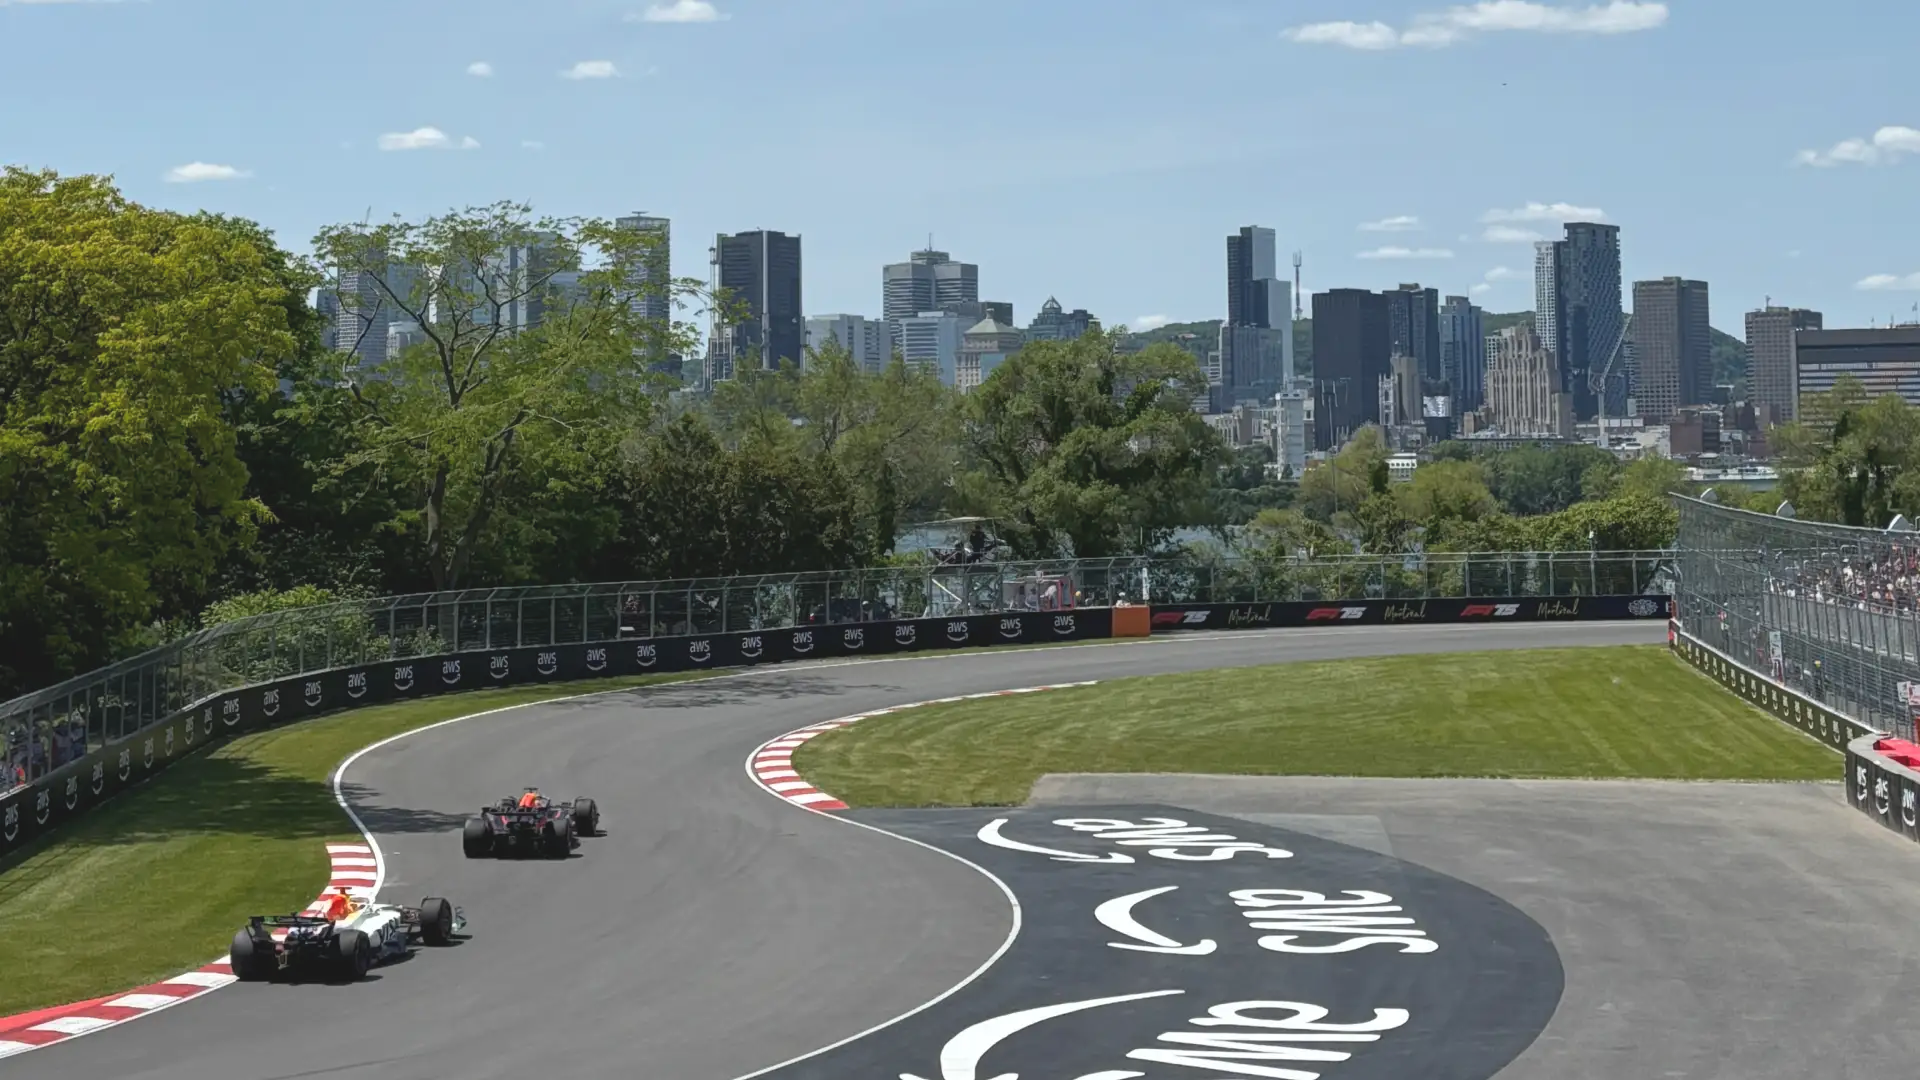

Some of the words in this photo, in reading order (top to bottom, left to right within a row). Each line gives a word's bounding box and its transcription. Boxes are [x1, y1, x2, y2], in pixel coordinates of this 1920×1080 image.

[948, 621, 968, 633] aws
[1000, 618, 1021, 630] aws
[1054, 615, 1074, 627] aws
[793, 631, 812, 644] aws
[844, 628, 863, 640] aws
[895, 625, 915, 637] aws
[690, 640, 710, 653] aws
[742, 636, 762, 649] aws
[586, 648, 606, 661] aws
[637, 644, 656, 657] aws
[490, 655, 509, 669] aws
[537, 652, 557, 665] aws
[394, 665, 413, 680] aws
[442, 660, 460, 674] aws
[348, 672, 366, 688] aws
[305, 680, 321, 696] aws
[263, 689, 279, 706] aws
[223, 698, 239, 715] aws
[1052, 817, 1294, 861] aws
[1229, 888, 1439, 954] aws
